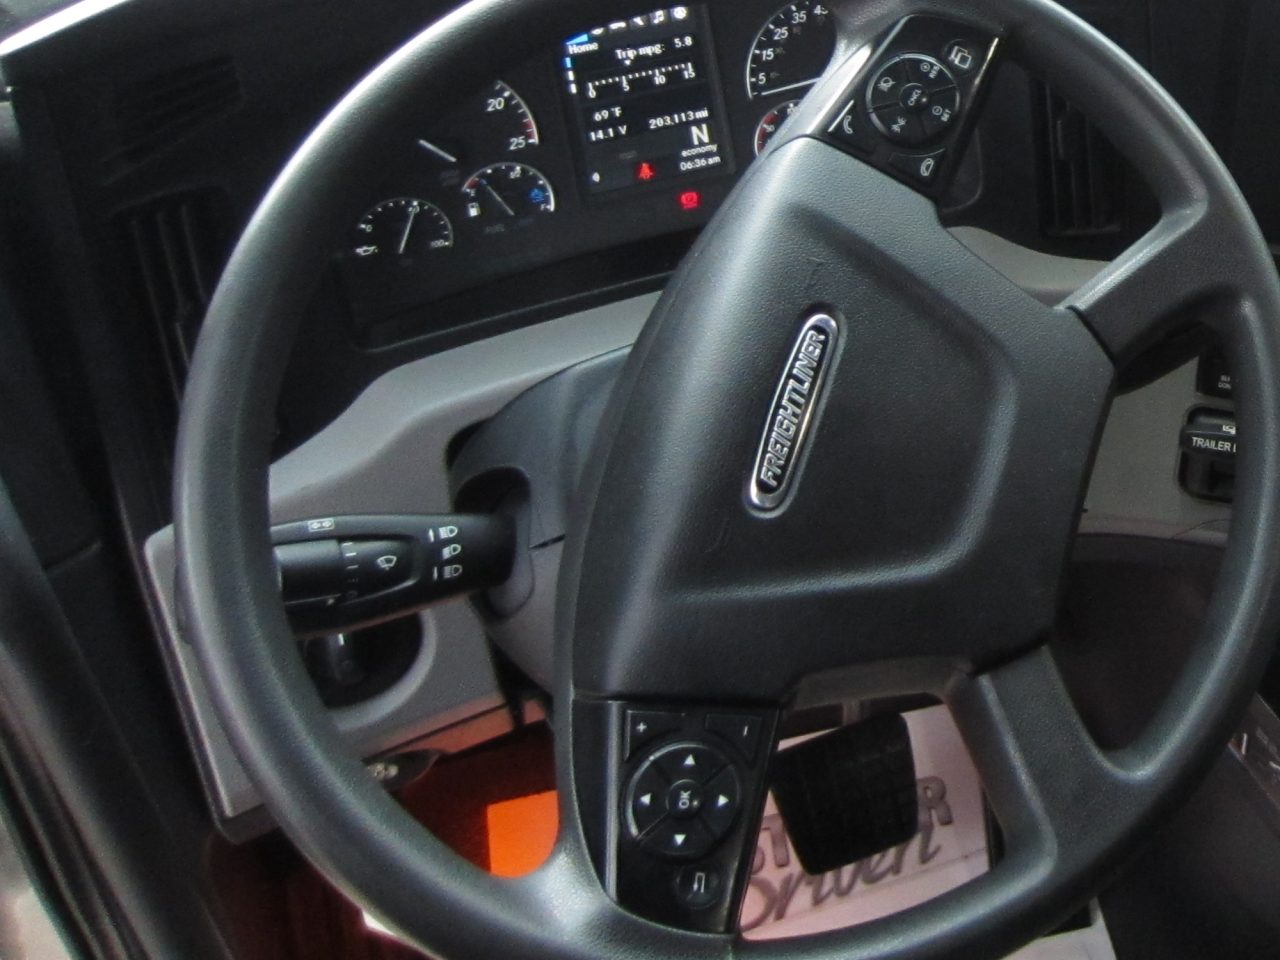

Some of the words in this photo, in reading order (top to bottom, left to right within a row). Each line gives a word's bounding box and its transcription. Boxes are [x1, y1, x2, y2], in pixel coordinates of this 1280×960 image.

[792, 10, 807, 24] 35
[773, 27, 788, 40] 25
[568, 41, 599, 55] Home
[615, 46, 637, 60] Trip
[674, 36, 693, 49] 5.8
[762, 48, 774, 61] 15
[653, 75, 666, 85] 10
[682, 70, 696, 80] 15
[758, 72, 767, 85] 5
[486, 97, 505, 113] 20
[594, 109, 610, 122] 69
[589, 128, 615, 141] 14.1
[618, 125, 628, 136] V
[690, 123, 710, 145] N
[508, 136, 527, 151] 25
[681, 143, 718, 158] economy
[679, 159, 707, 172] 06:36
[707, 155, 721, 165] am
[760, 329, 826, 487] FREIGHTLINER
[1192, 436, 1231, 451] TRAILER
[677, 790, 692, 809] OK
